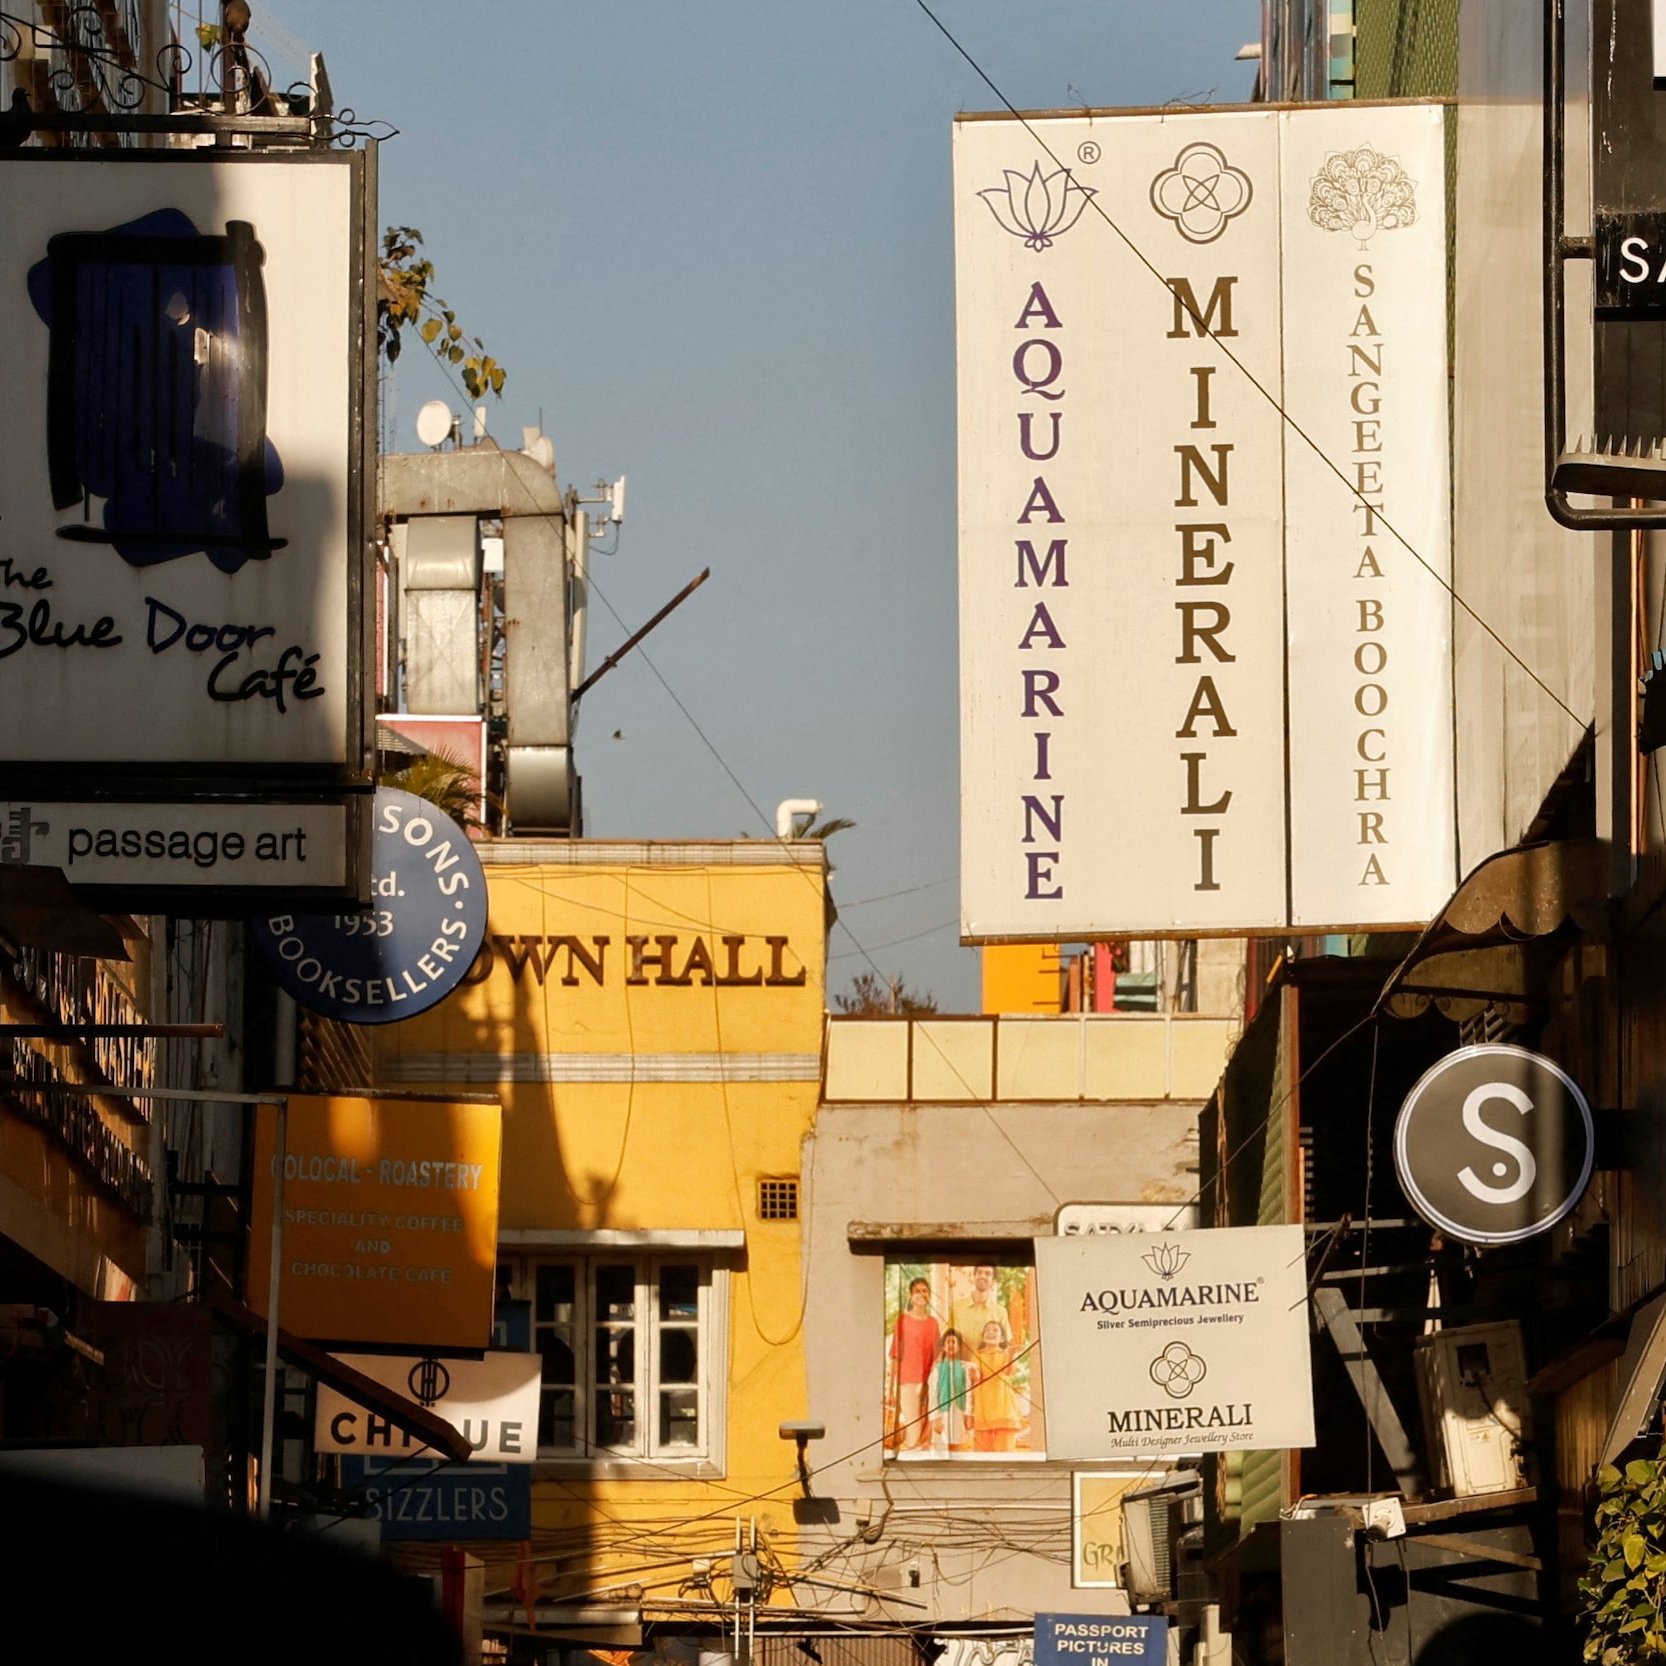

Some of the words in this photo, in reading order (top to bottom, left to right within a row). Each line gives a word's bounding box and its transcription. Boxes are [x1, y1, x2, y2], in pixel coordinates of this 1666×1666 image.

[1347, 264, 1385, 578] SANGEETA
[1013, 280, 1069, 900] AQUAMARINE
[1166, 276, 1239, 891] MINERALI
[144, 596, 276, 655] Door
[207, 646, 325, 714] Café
[1353, 599, 1391, 887] BOOCHRA
[69, 826, 245, 868] passage
[256, 827, 308, 863] art
[372, 805, 470, 896] SONS
[268, 914, 468, 1005] BOOKSELLERS
[463, 935, 610, 987] OWN
[626, 935, 807, 987] HALL
[1457, 1082, 1536, 1204] S
[379, 1159, 483, 1191] ROASTERY
[284, 1209, 389, 1227] SPECIALITY
[395, 1215, 463, 1233] COFFEE
[354, 1239, 392, 1254] AND
[291, 1261, 398, 1281] CHOCOLATE
[1080, 1282, 1259, 1315] AQUAMARINE
[1097, 1319, 1125, 1330] Silver
[1128, 1316, 1194, 1329] Semiprecious
[1197, 1314, 1244, 1325] Jewellery
[330, 1412, 522, 1454] CHUE
[1107, 1403, 1253, 1433] MINERALI
[1111, 1436, 1139, 1448] Multi
[1141, 1434, 1182, 1449] Designer
[1184, 1431, 1229, 1446] Jewellery
[1229, 1431, 1254, 1442] Store
[1054, 1624, 1149, 1639] PASSPORT
[1057, 1640, 1145, 1655] PICTURES
